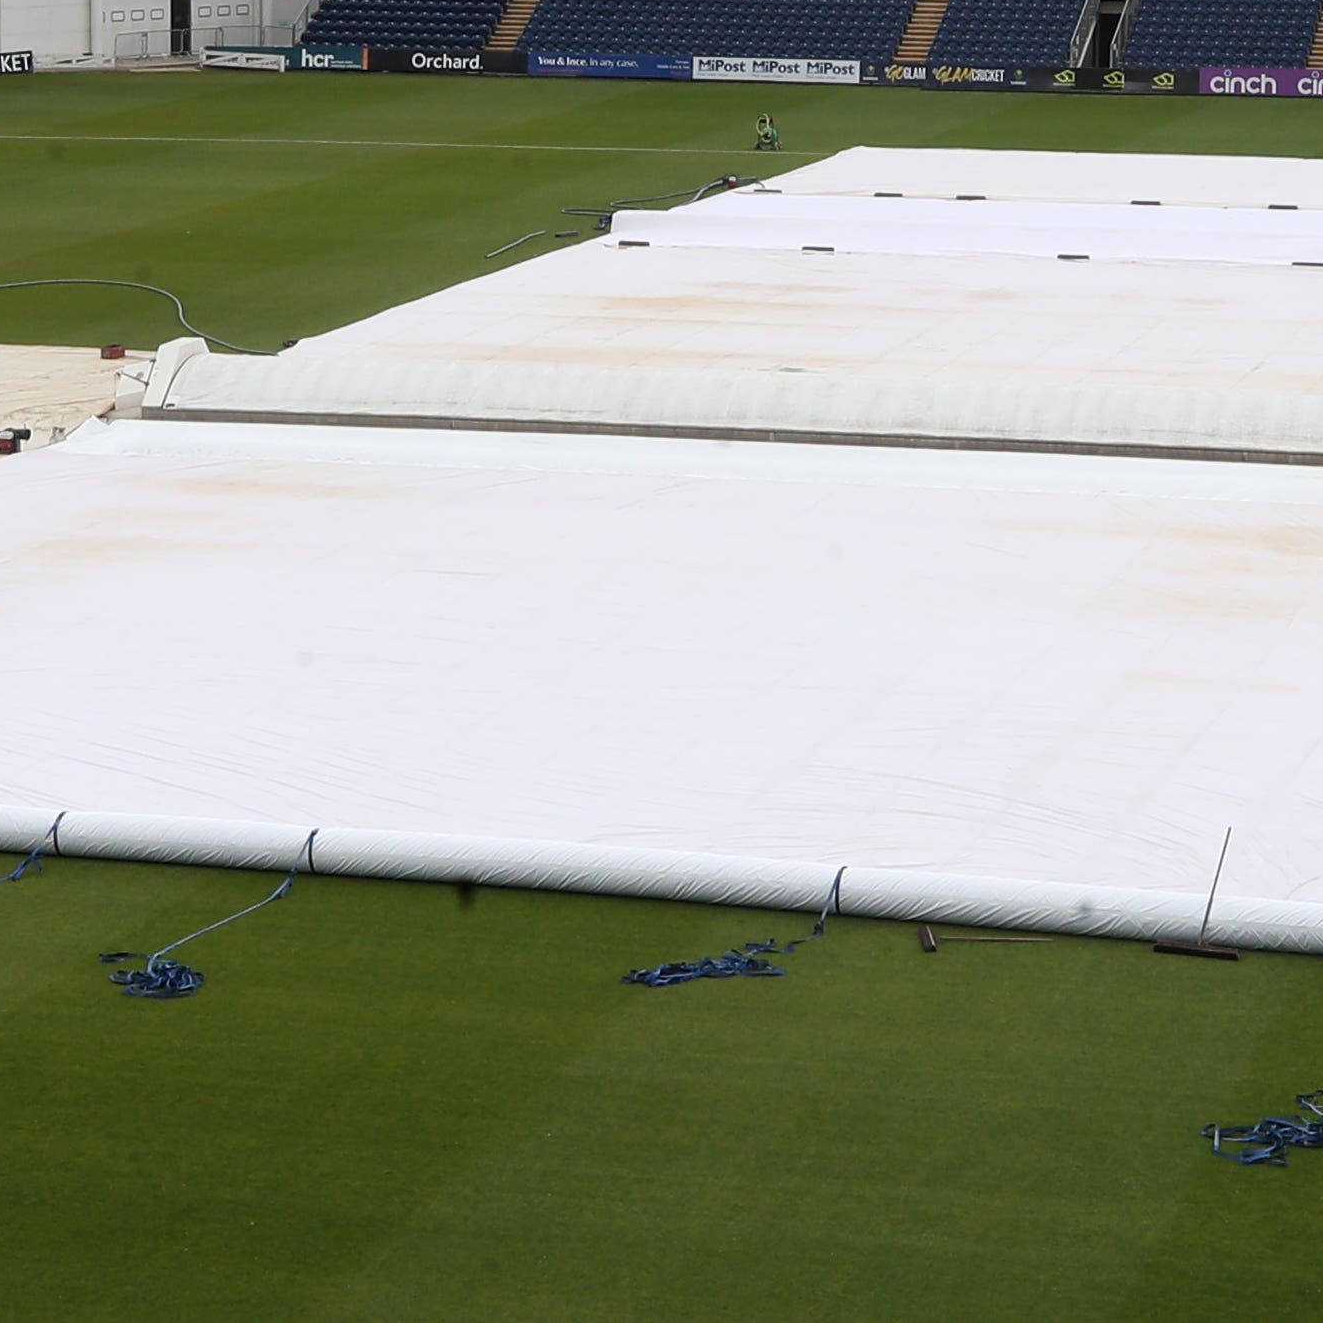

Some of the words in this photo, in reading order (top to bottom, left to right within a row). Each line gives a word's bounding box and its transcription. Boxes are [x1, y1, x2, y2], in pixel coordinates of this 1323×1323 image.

[301, 49, 334, 68] hcr
[411, 53, 484, 70] Orchard.
[538, 56, 556, 66] You
[556, 57, 565, 66] &
[599, 60, 614, 69] any
[698, 59, 746, 73] MiPost
[753, 60, 801, 74] MiPost
[806, 61, 855, 76] MiPost
[1210, 69, 1277, 95] cinch
